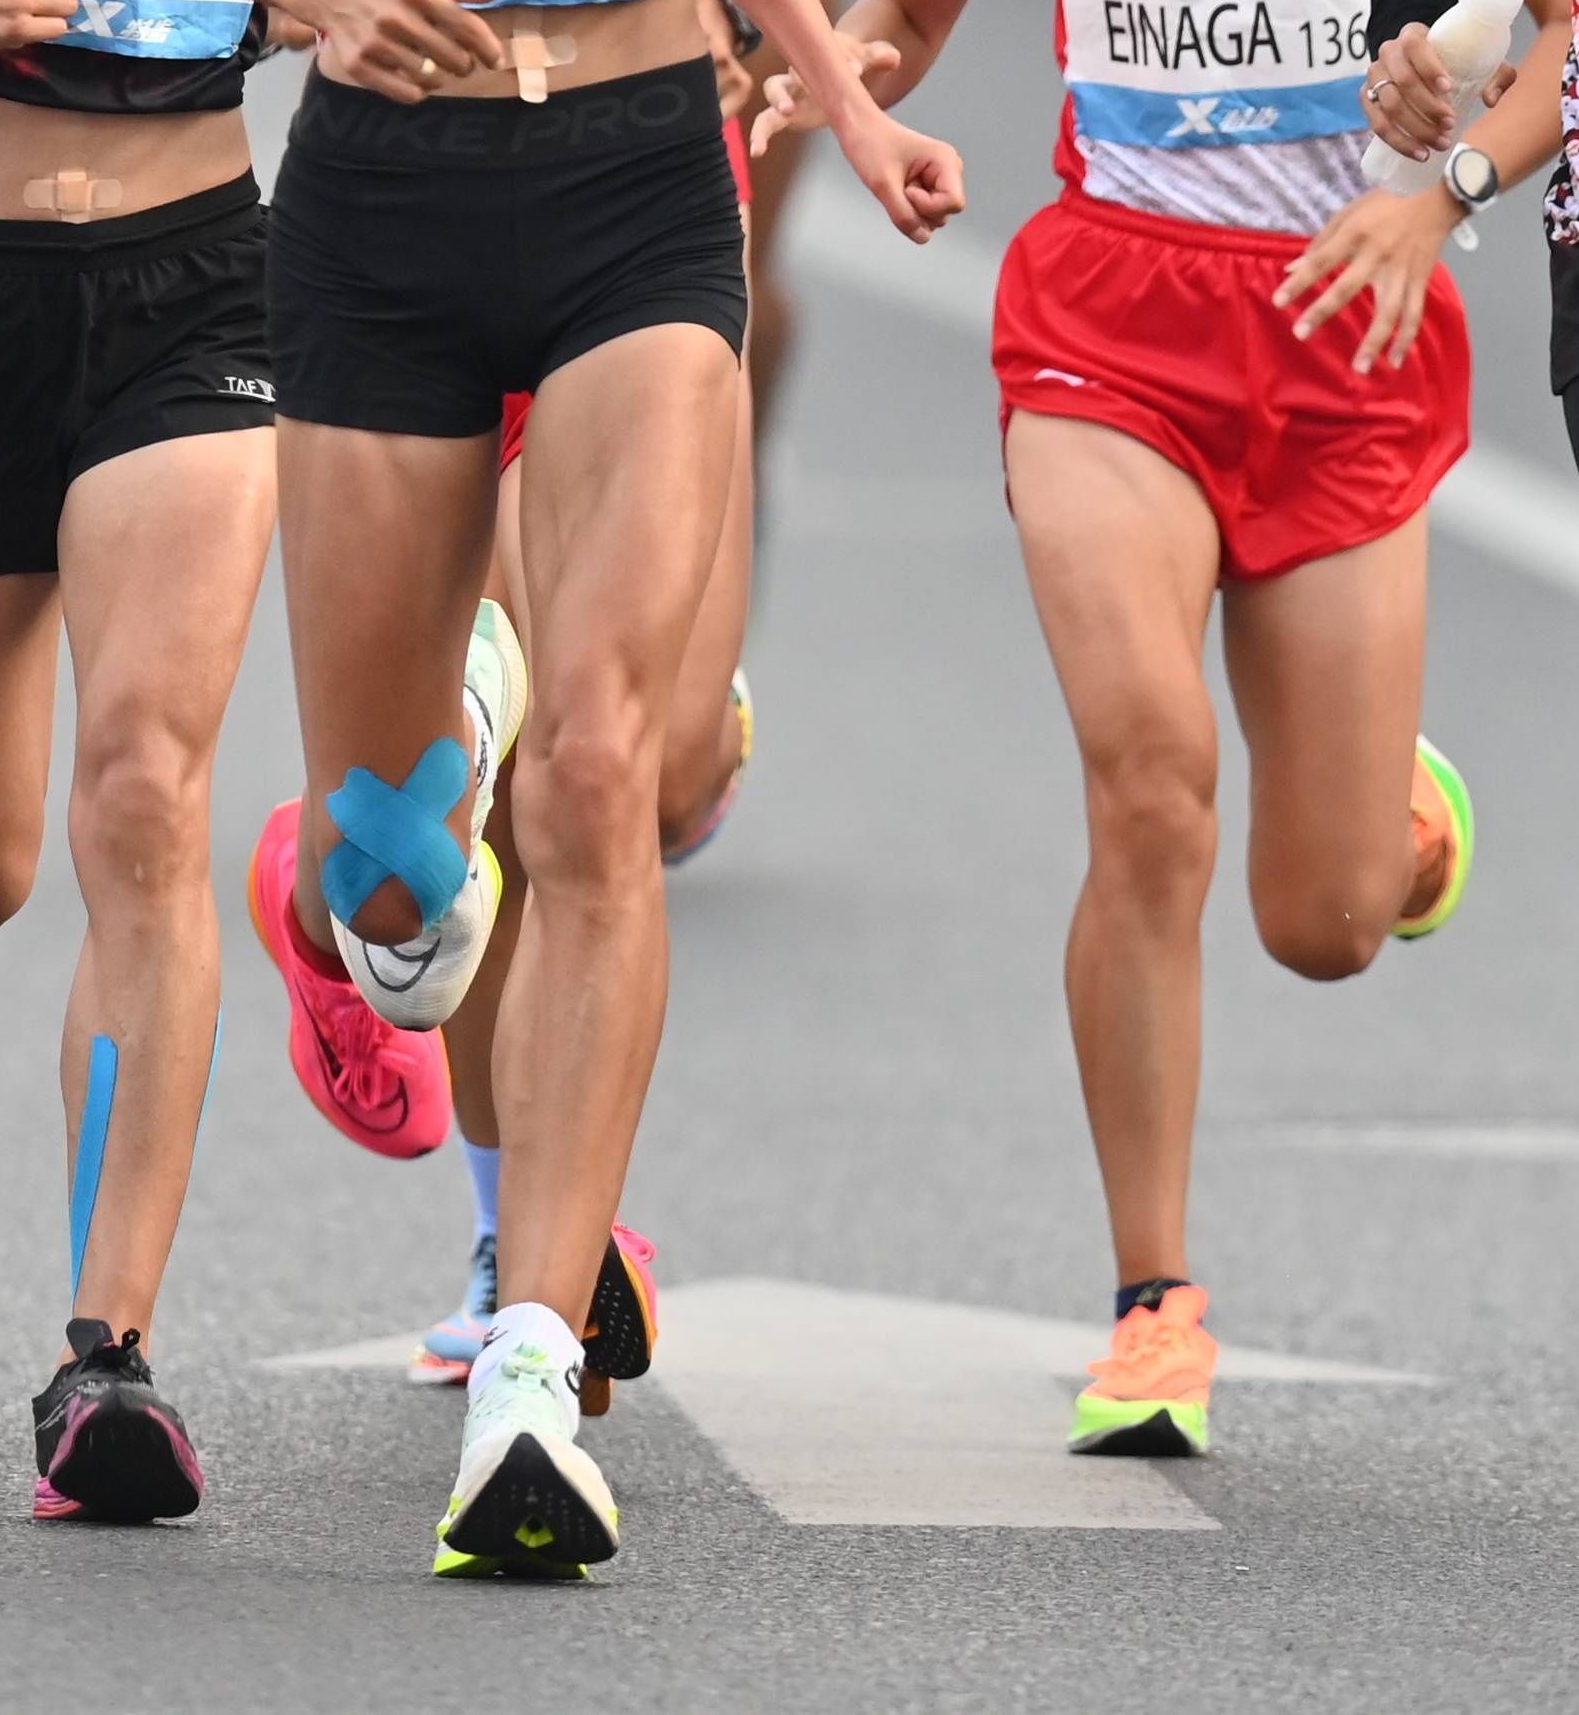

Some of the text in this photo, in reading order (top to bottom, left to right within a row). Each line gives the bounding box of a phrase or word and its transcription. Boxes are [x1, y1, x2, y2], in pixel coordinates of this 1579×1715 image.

[1104, 0, 1367, 70] EINAGA 136
[300, 82, 690, 157] NIKE PRO
